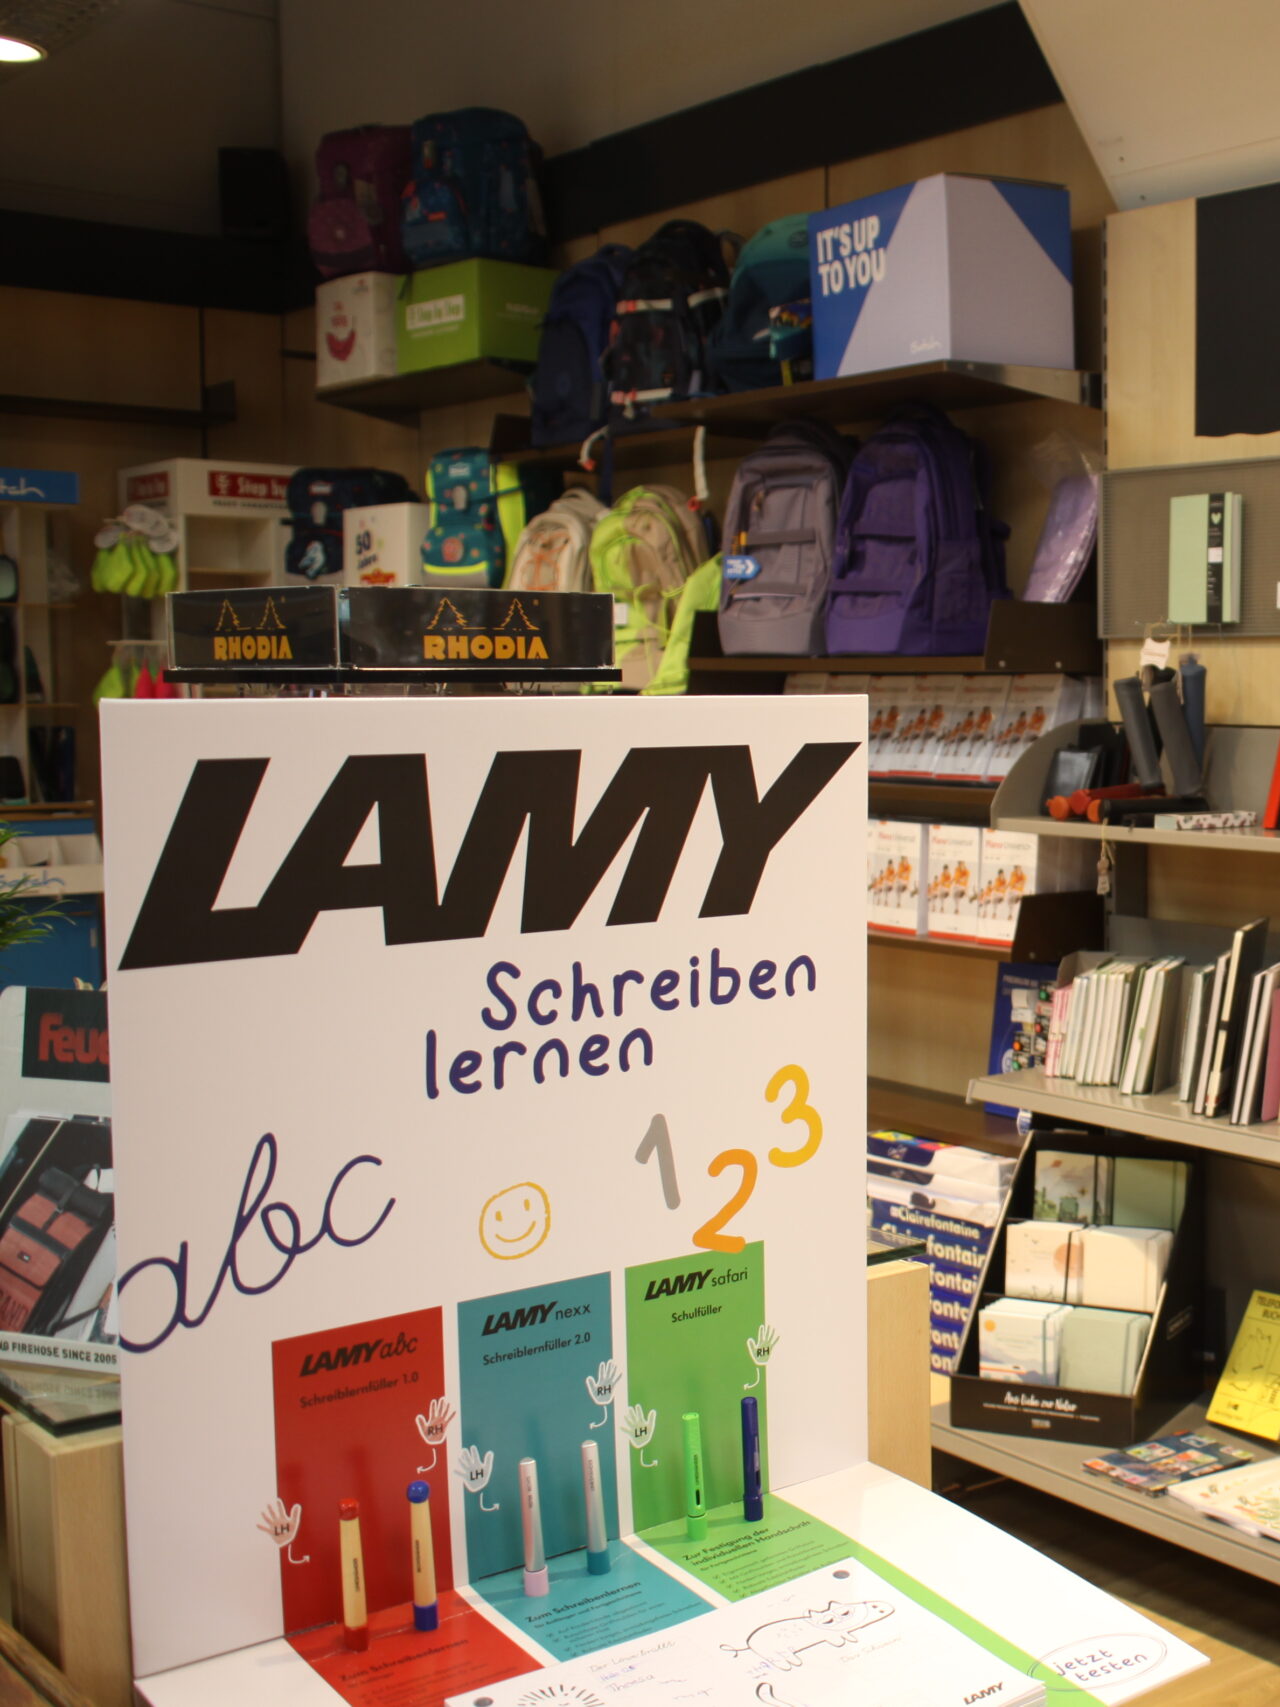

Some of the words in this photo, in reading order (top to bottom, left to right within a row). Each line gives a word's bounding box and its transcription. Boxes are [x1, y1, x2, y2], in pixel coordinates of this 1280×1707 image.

[853, 215, 880, 252] UP
[818, 260, 844, 297] TO
[844, 247, 887, 289] YOU
[213, 635, 294, 660] RHODIA
[423, 634, 549, 660] RHODIA
[117, 741, 863, 971] LAMY
[481, 947, 817, 1031] Schreiben
[424, 1026, 654, 1099] lernen
[635, 1113, 682, 1210] 1
[692, 1149, 758, 1254] 2
[764, 1063, 823, 1168] 3
[117, 1132, 396, 1354] abc
[644, 1268, 712, 1301] LAMY
[710, 1267, 749, 1288] safari
[481, 1301, 558, 1337] LAMY
[555, 1302, 592, 1321] nexx
[671, 1304, 723, 1324] Schulfüller
[12, 1341, 60, 1358] FIREHOSE
[62, 1348, 92, 1363] SINCE
[94, 1352, 118, 1365] 2005
[298, 1338, 381, 1377] LAMY
[380, 1332, 419, 1361] abc
[482, 1336, 572, 1367] Schreiblernfüller
[574, 1331, 592, 1346] 2.0
[756, 1345, 771, 1358] RH
[299, 1378, 398, 1409] Schreiblernfüller
[402, 1372, 419, 1386] 1.0
[596, 1383, 612, 1397] RH
[427, 1423, 444, 1437] RH
[633, 1425, 648, 1439] LH
[469, 1468, 485, 1482] LH
[272, 1522, 290, 1538] LH
[526, 1612, 552, 1623] Zum
[1053, 1649, 1113, 1677] jetzt
[1075, 1652, 1148, 1682] testen
[963, 1681, 1004, 1705] LAMY
